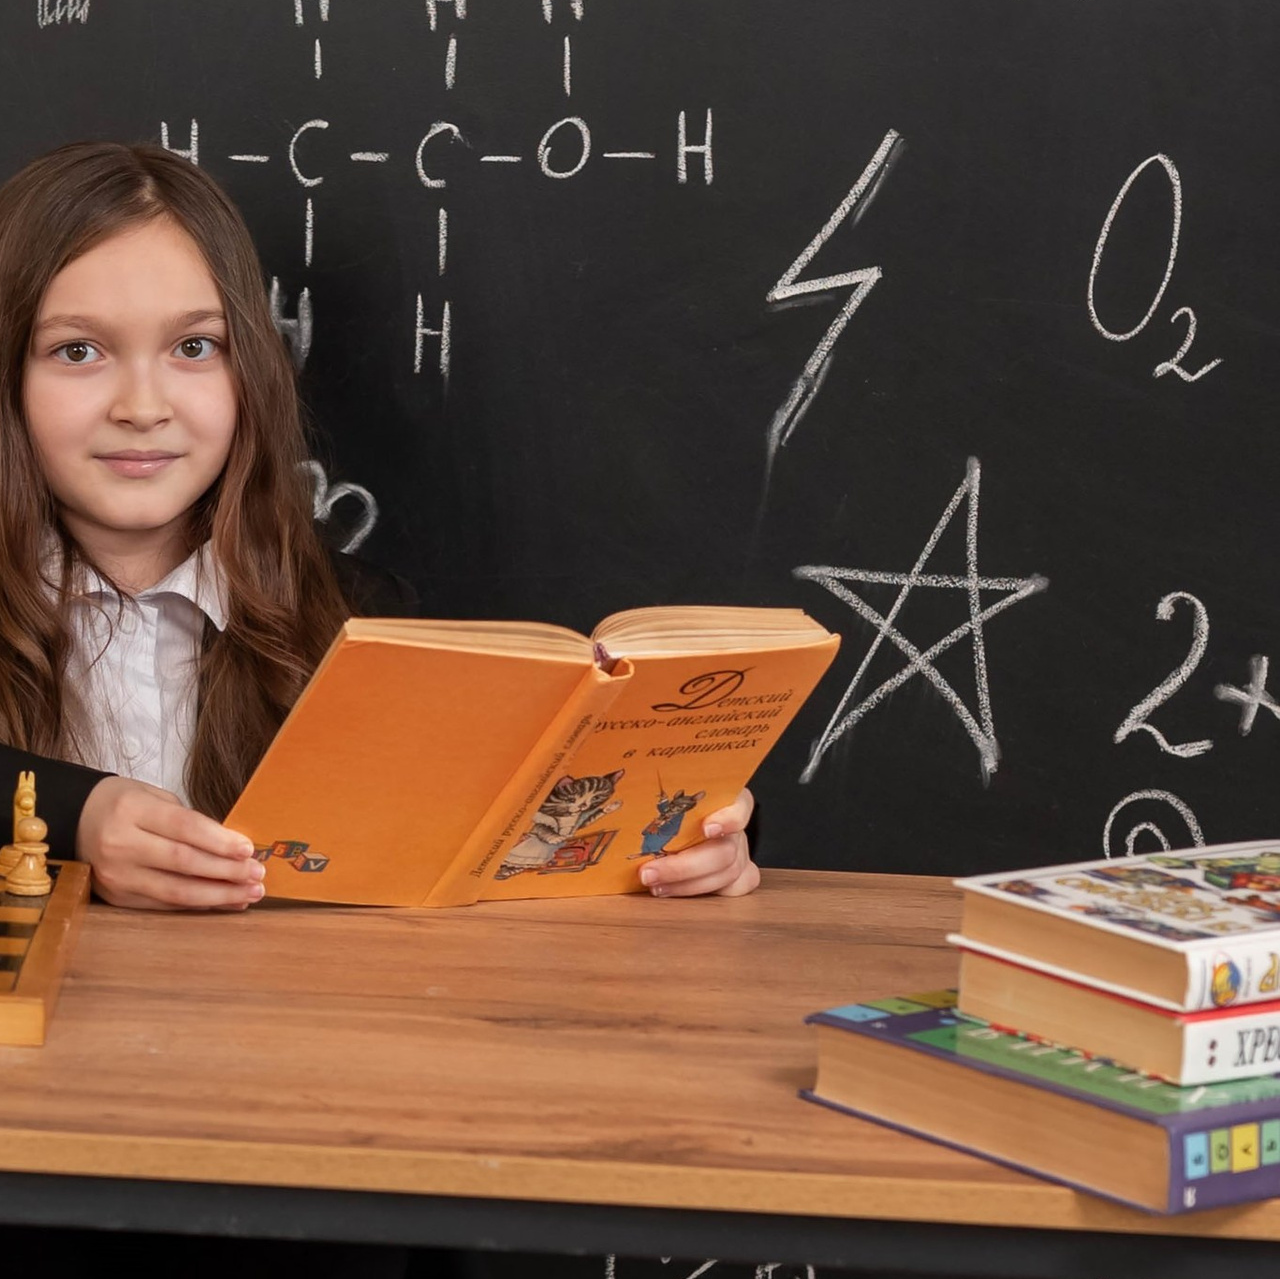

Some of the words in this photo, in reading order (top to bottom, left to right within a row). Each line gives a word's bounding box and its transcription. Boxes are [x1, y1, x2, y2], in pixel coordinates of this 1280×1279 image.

[650, 665, 794, 713] Детский
[621, 748, 638, 760] в
[645, 737, 763, 759] картинках
[694, 723, 772, 740] словарь
[470, 837, 505, 879] Детский
[1233, 1024, 1280, 1068] ХРЕ
